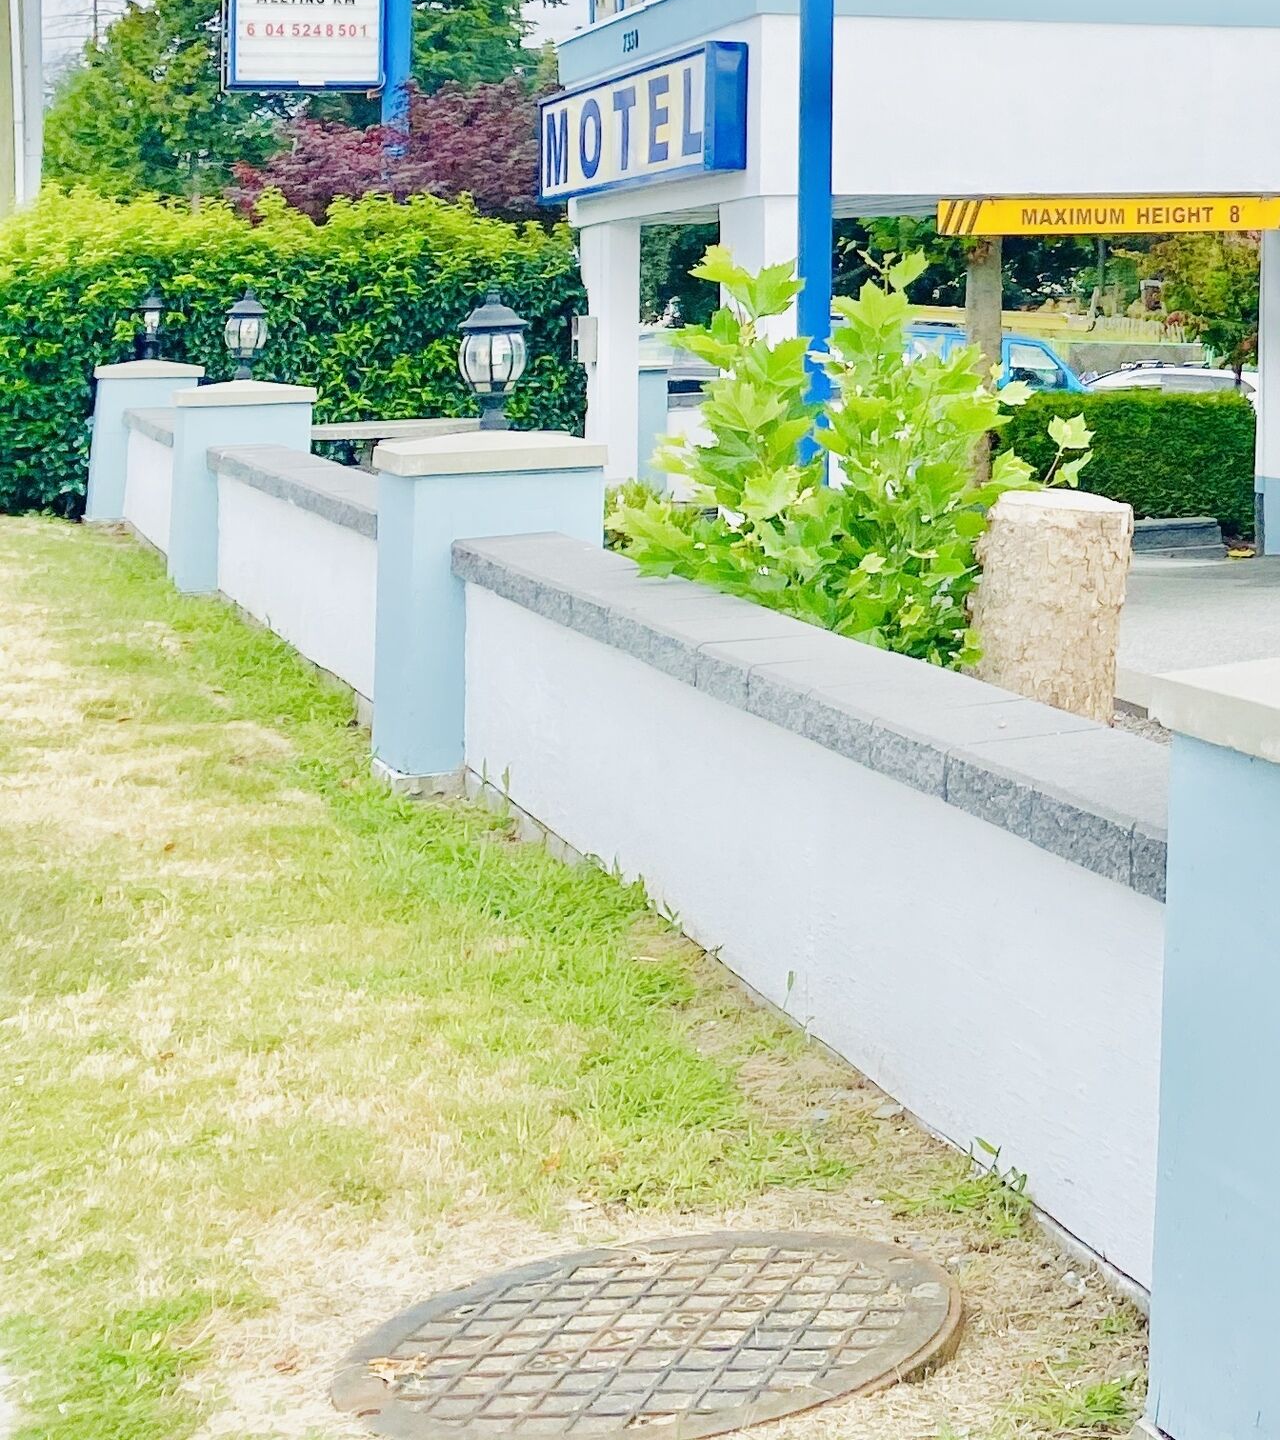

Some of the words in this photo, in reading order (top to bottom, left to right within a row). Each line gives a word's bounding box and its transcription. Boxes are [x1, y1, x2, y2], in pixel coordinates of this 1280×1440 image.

[546, 68, 702, 188] MOTEL
[1021, 208, 1125, 226] MAXIMUM
[1137, 206, 1214, 224] HEIGHT
